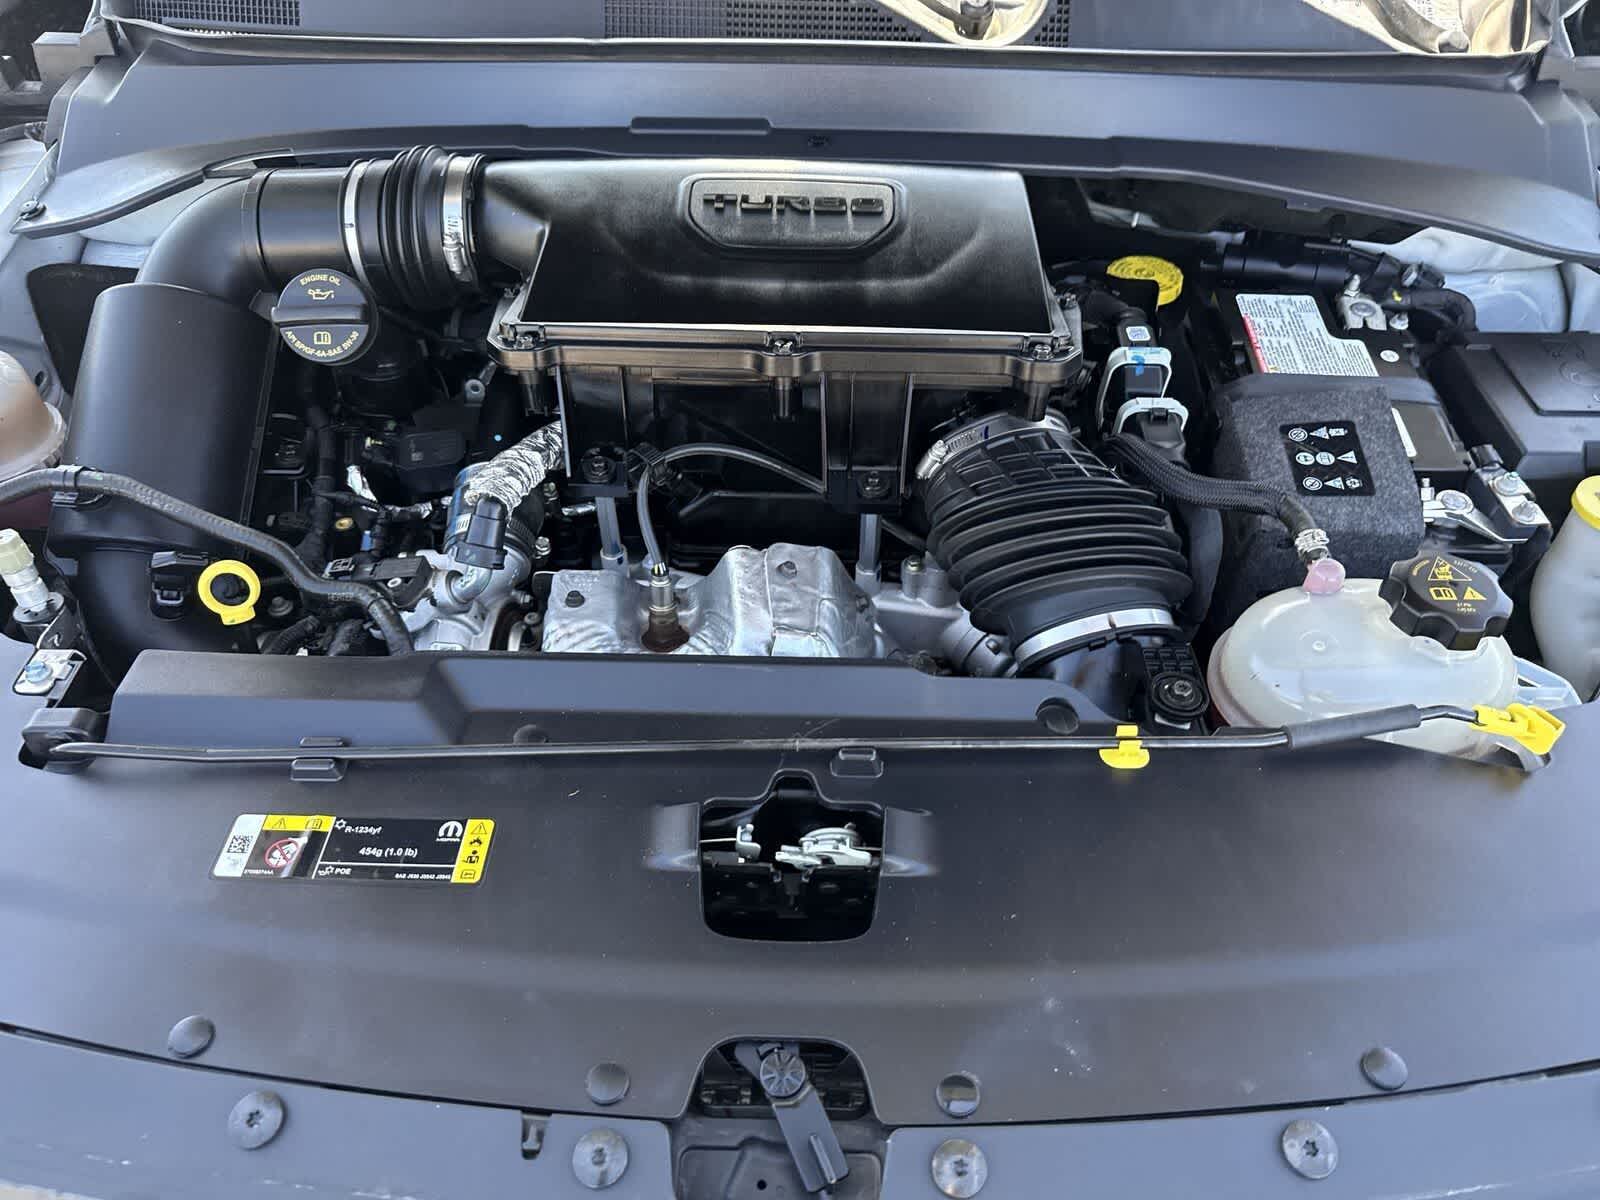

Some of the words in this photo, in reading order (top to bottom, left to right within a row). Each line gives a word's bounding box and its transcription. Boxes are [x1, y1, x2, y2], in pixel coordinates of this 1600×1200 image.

[703, 193, 884, 213] TURBO
[300, 274, 328, 286] ENGINE
[329, 275, 341, 286] OIL
[344, 825, 382, 835] R-1234yf
[359, 847, 382, 857] 454g
[384, 847, 403, 857] (1.0
[404, 847, 418, 858] lb)
[335, 867, 352, 875] POE
